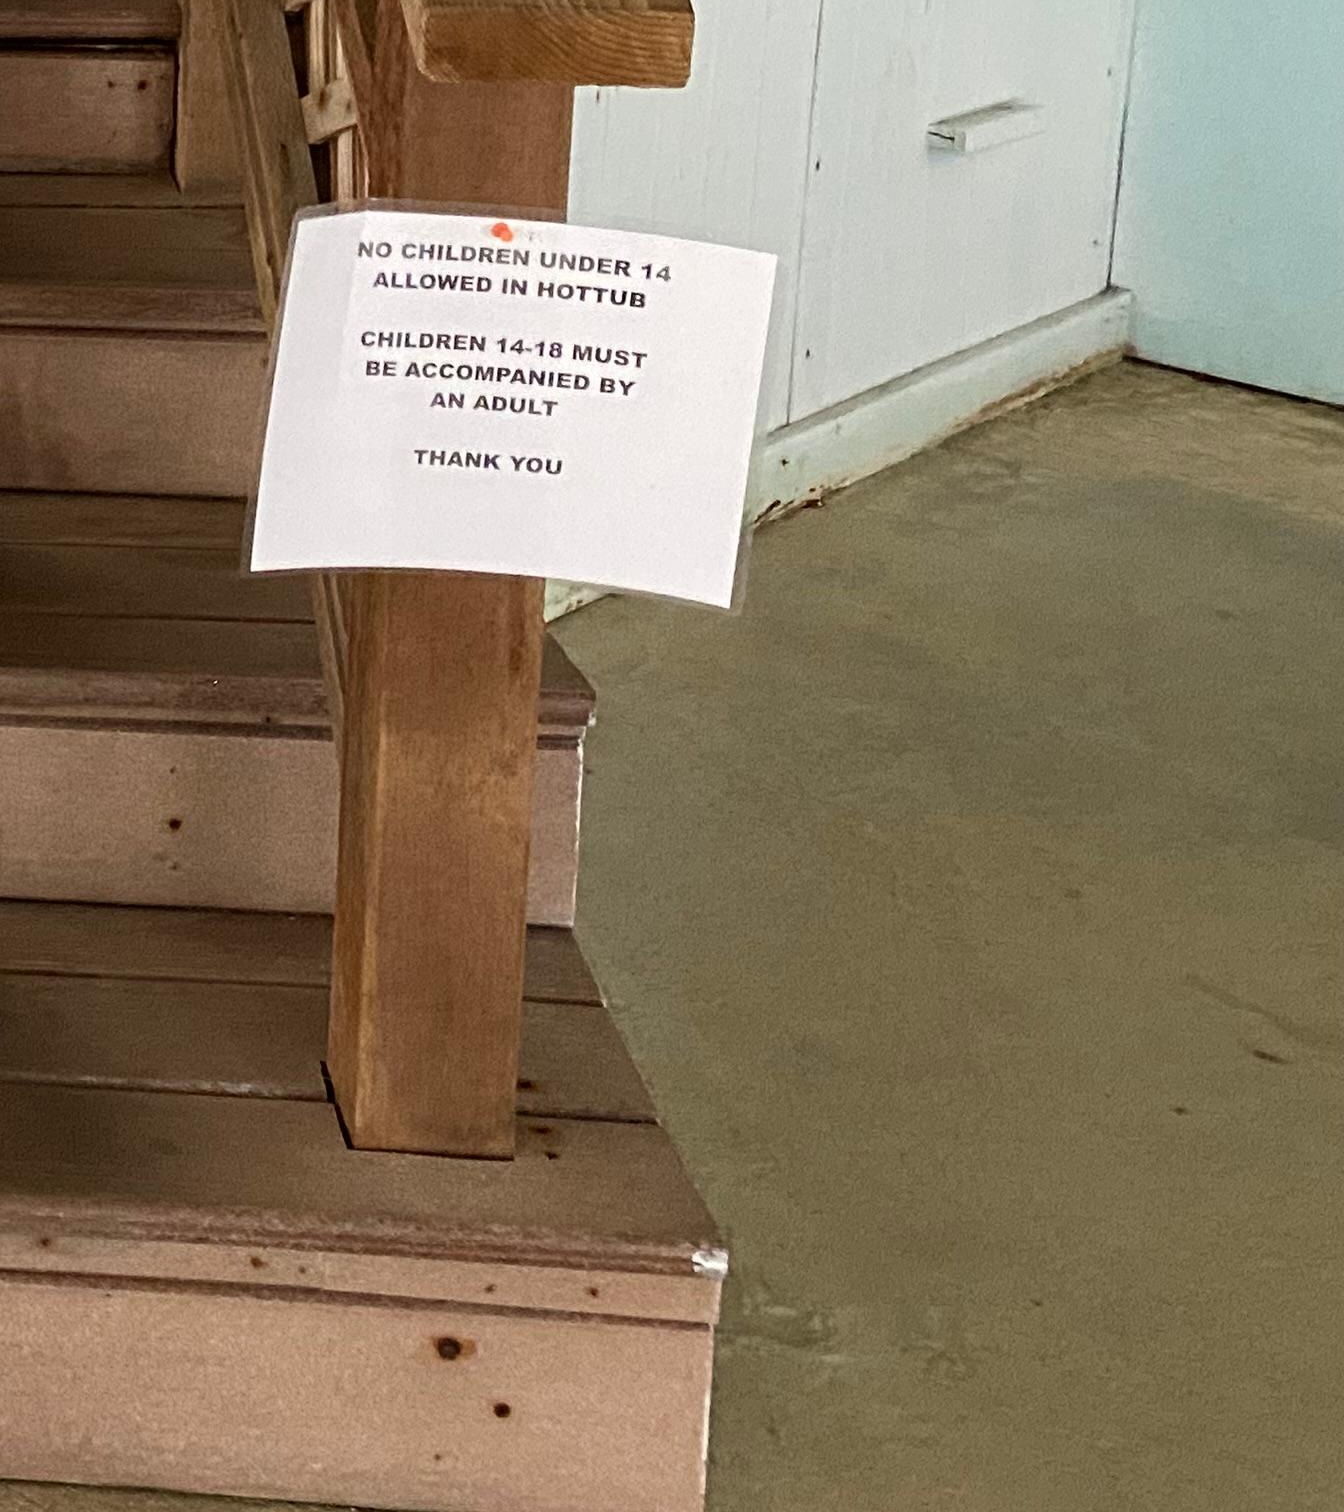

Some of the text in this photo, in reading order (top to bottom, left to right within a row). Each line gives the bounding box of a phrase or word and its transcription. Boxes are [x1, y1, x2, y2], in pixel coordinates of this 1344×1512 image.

[358, 241, 671, 282] NO CHILDREN UNDER 14
[372, 272, 646, 308] ALLOWED IN HOTTUB
[361, 331, 647, 369] CHILDREN 14-18 MUST
[365, 360, 635, 397] BE ACCOMPANIED BY
[430, 392, 558, 417] AN ADULT
[414, 449, 563, 475] THANK YOU
